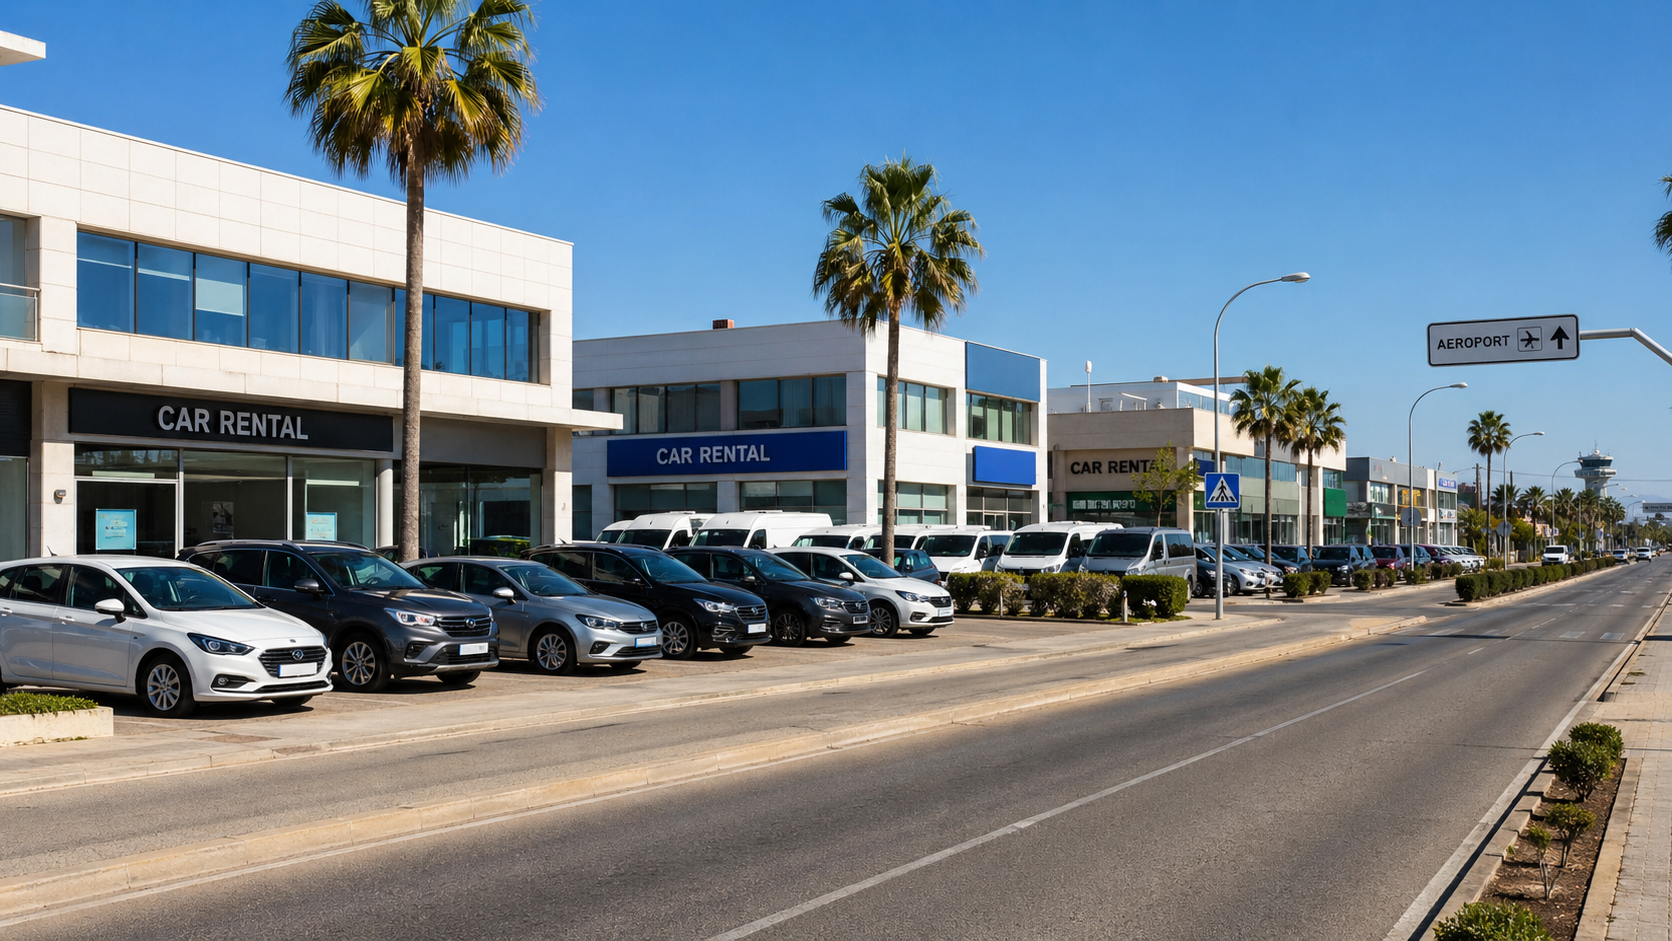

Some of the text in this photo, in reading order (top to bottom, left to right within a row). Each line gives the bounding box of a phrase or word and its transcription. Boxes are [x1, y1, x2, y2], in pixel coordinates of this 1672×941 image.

[1437, 335, 1510, 350] AEROPORT
[158, 405, 309, 440] CAR RENTAL
[656, 444, 771, 465] CAR RENTAL
[1070, 459, 1170, 474] CAR RENT
